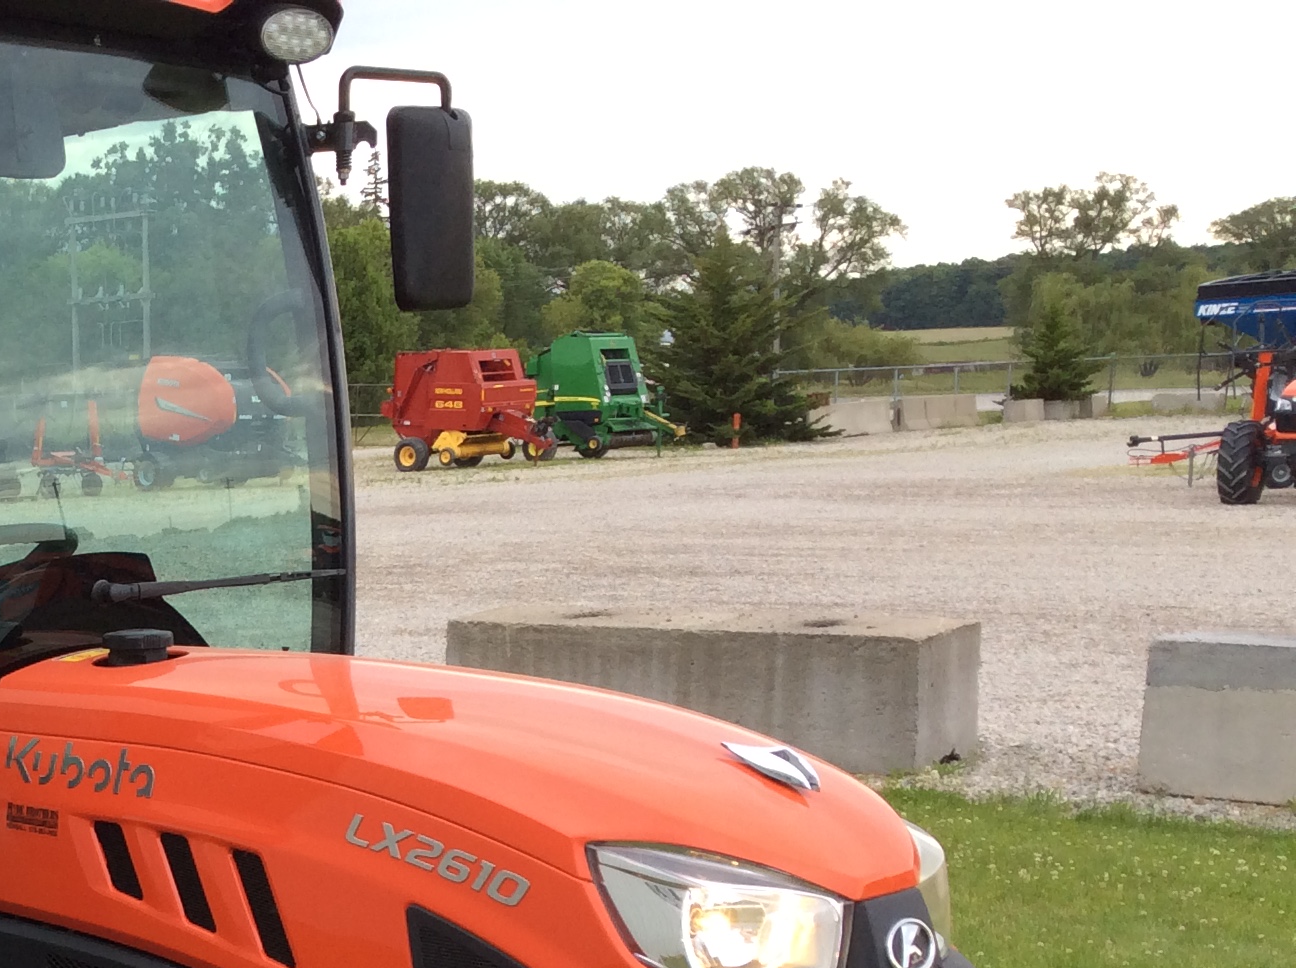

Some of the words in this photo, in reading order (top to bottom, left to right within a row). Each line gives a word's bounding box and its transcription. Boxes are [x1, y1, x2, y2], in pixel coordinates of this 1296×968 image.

[1197, 302, 1239, 317] KINZE
[5, 735, 155, 798] Kubota
[345, 813, 531, 907] LX2610
